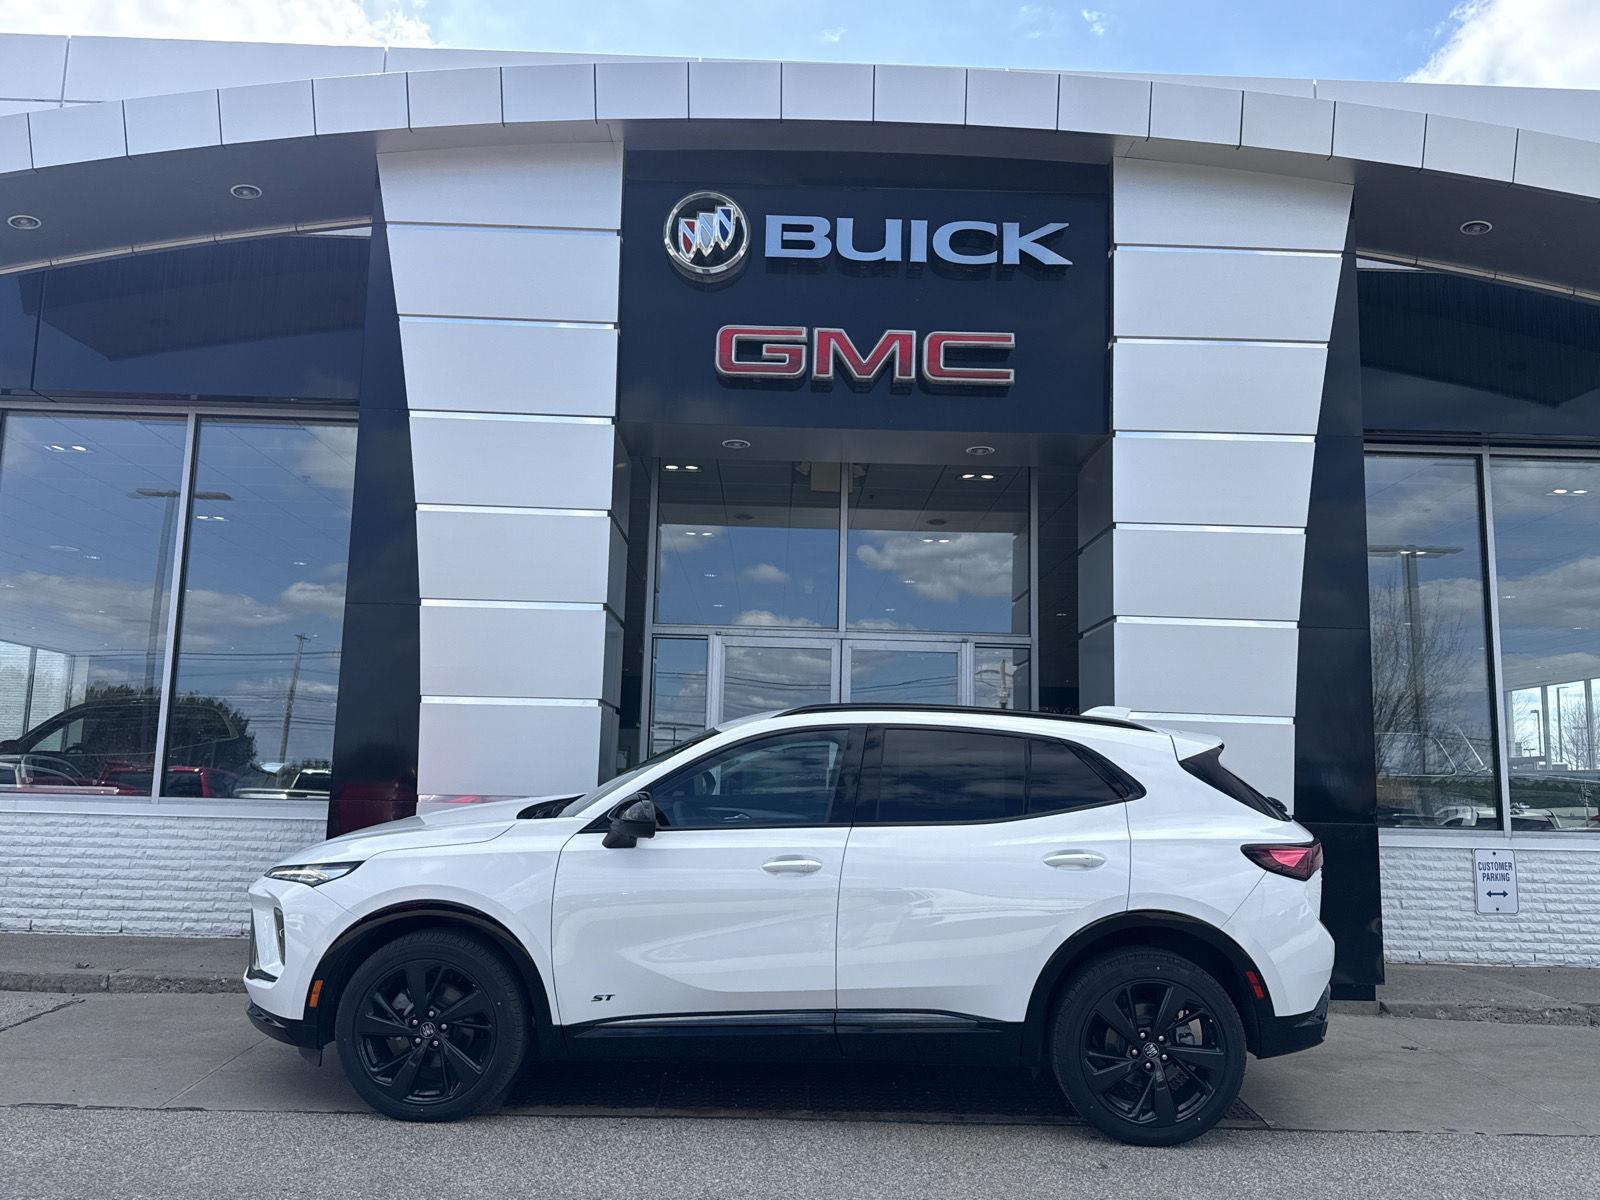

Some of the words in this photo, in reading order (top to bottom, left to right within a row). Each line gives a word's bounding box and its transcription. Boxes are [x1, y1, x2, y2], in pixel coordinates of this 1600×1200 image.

[764, 214, 1073, 266] BUICK
[715, 324, 1016, 386] GMC
[1477, 861, 1513, 871] CUSTOMER
[1482, 872, 1511, 882] PARKING
[591, 994, 616, 1002] ST
